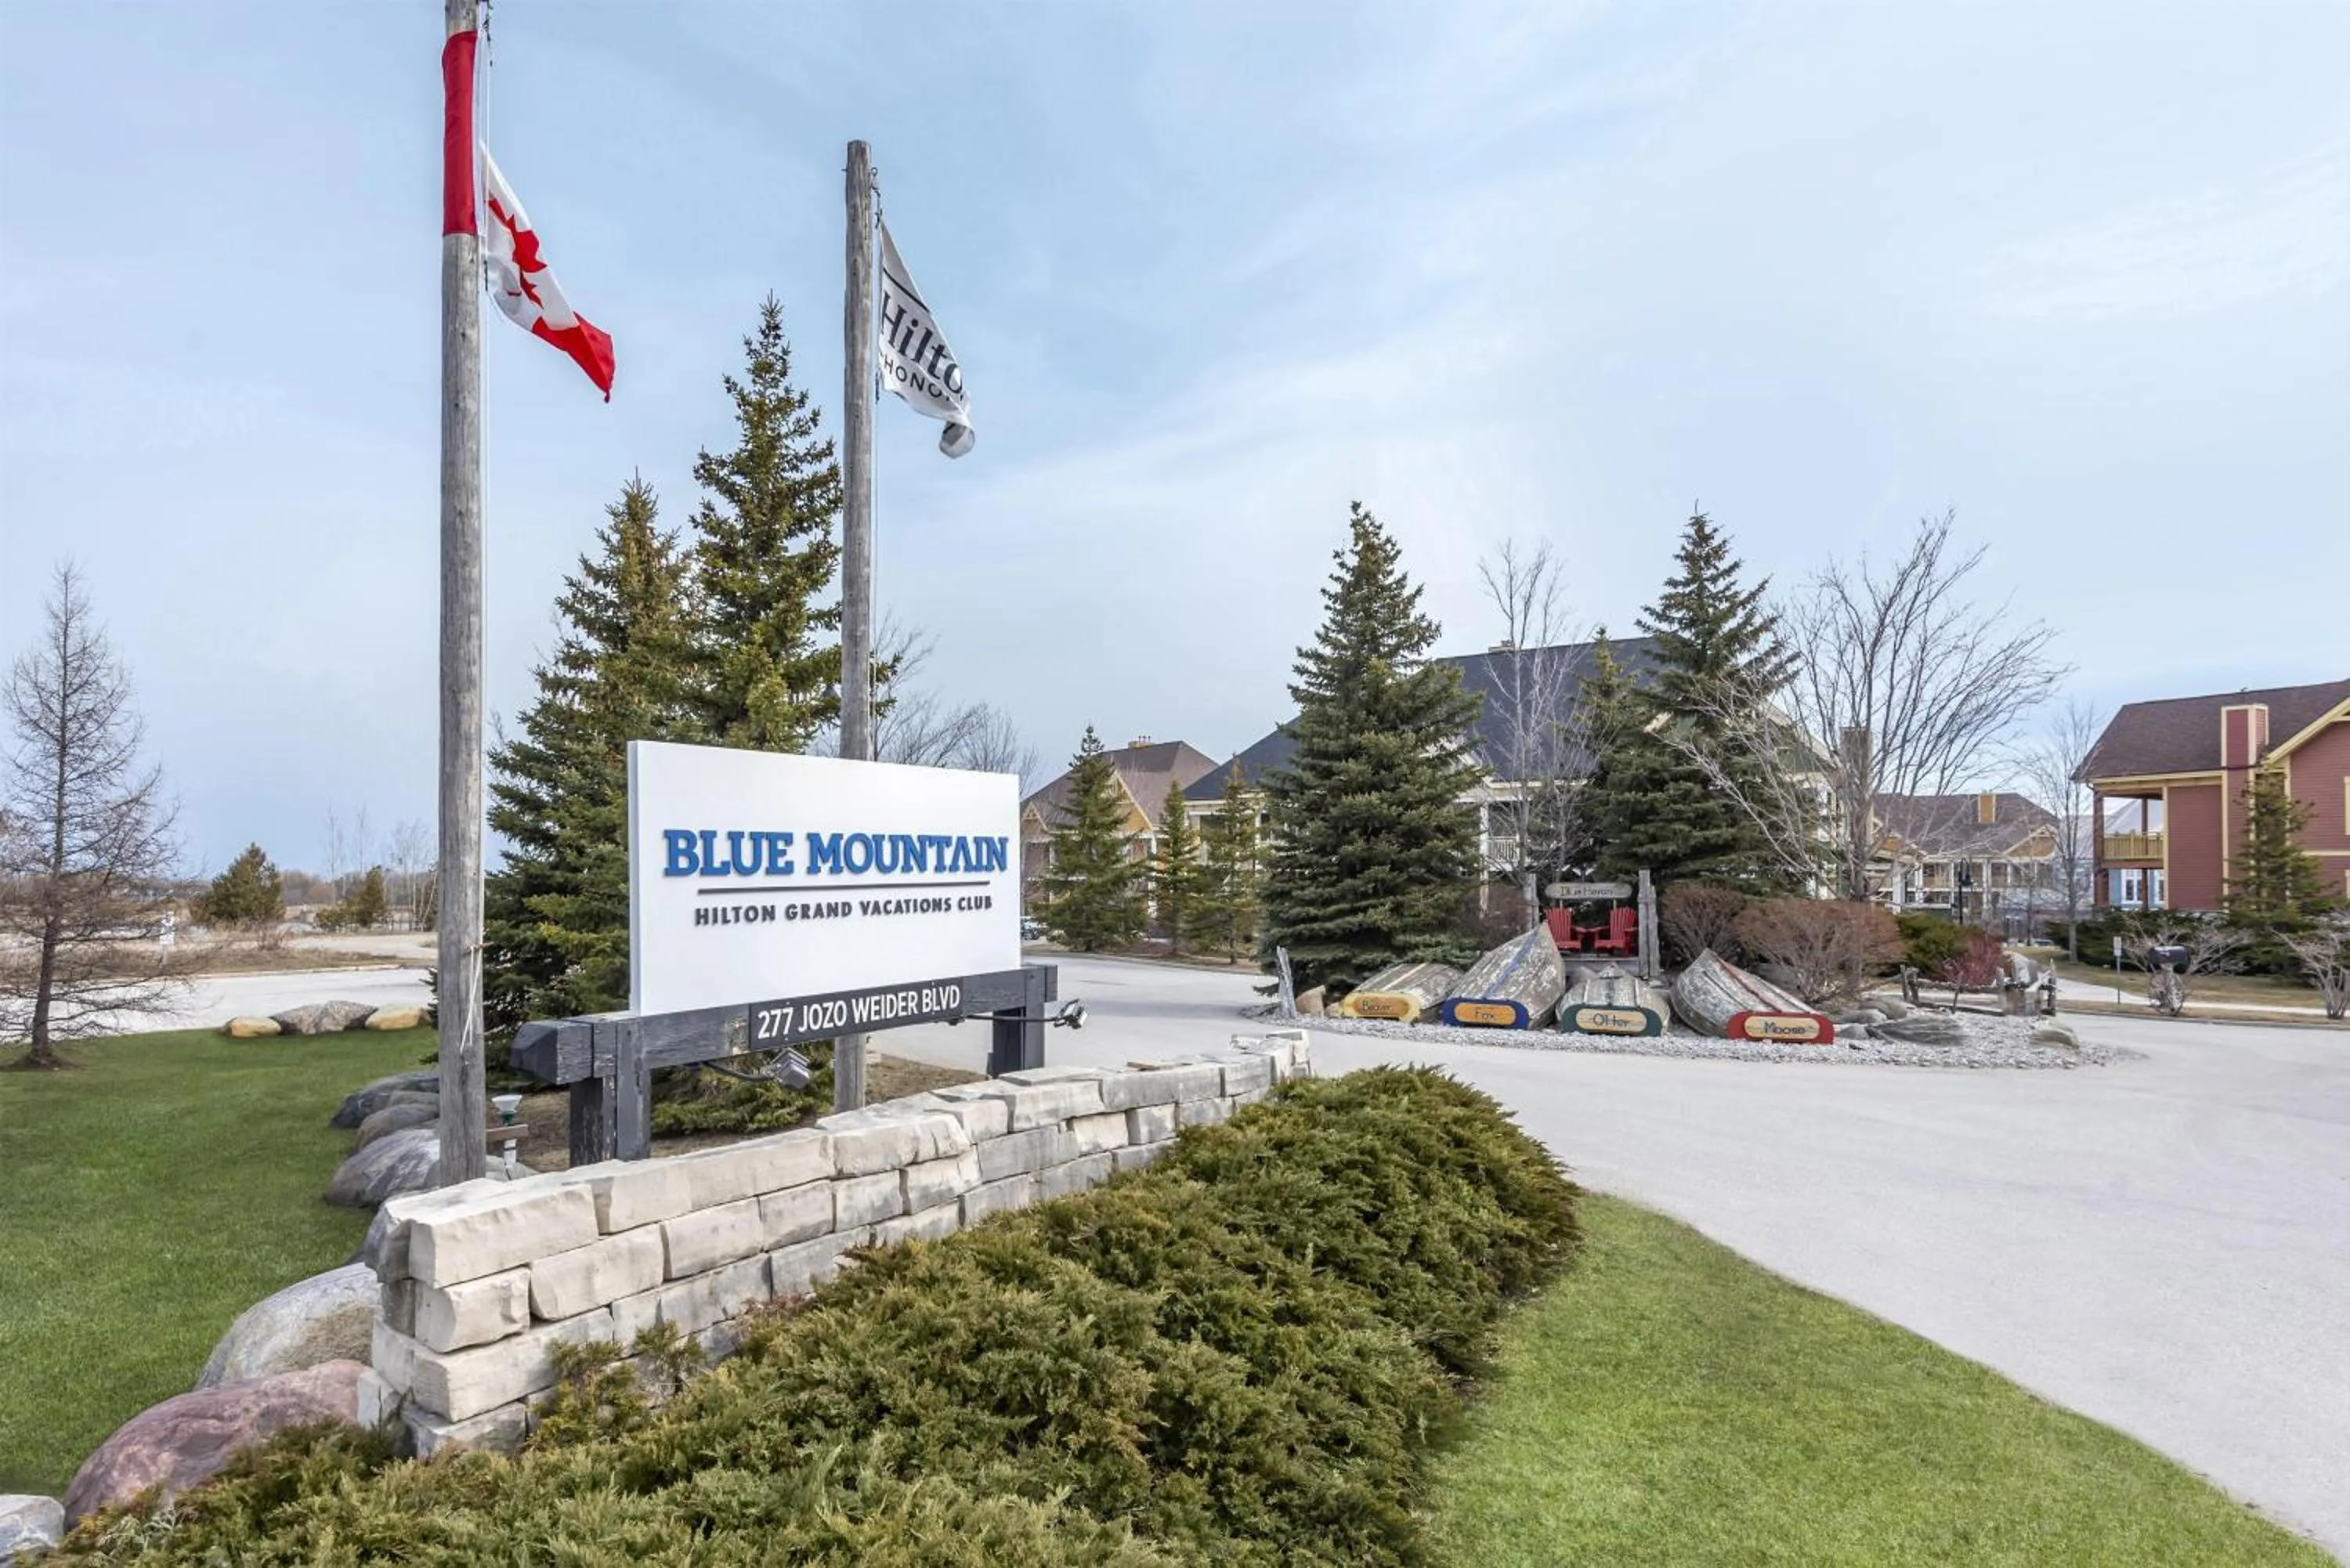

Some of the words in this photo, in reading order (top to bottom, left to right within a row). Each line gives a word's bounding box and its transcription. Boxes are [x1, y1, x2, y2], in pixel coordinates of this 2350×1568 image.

[880, 291, 964, 400] Hilto
[884, 357, 949, 401] HONO
[663, 829, 794, 876] BLUE
[807, 833, 1009, 874] MOUNTAIN
[695, 904, 776, 927] HILTON
[785, 901, 852, 920] GRAND
[861, 898, 952, 916] VACATIONS
[958, 895, 992, 911] CLUB
[757, 1010, 794, 1039] 277
[798, 1000, 847, 1032] JOZO
[851, 991, 918, 1021] WEIDER
[922, 985, 960, 1012] BLVD
[1475, 1007, 1495, 1020] Fox
[1763, 1021, 1806, 1035] Moose
